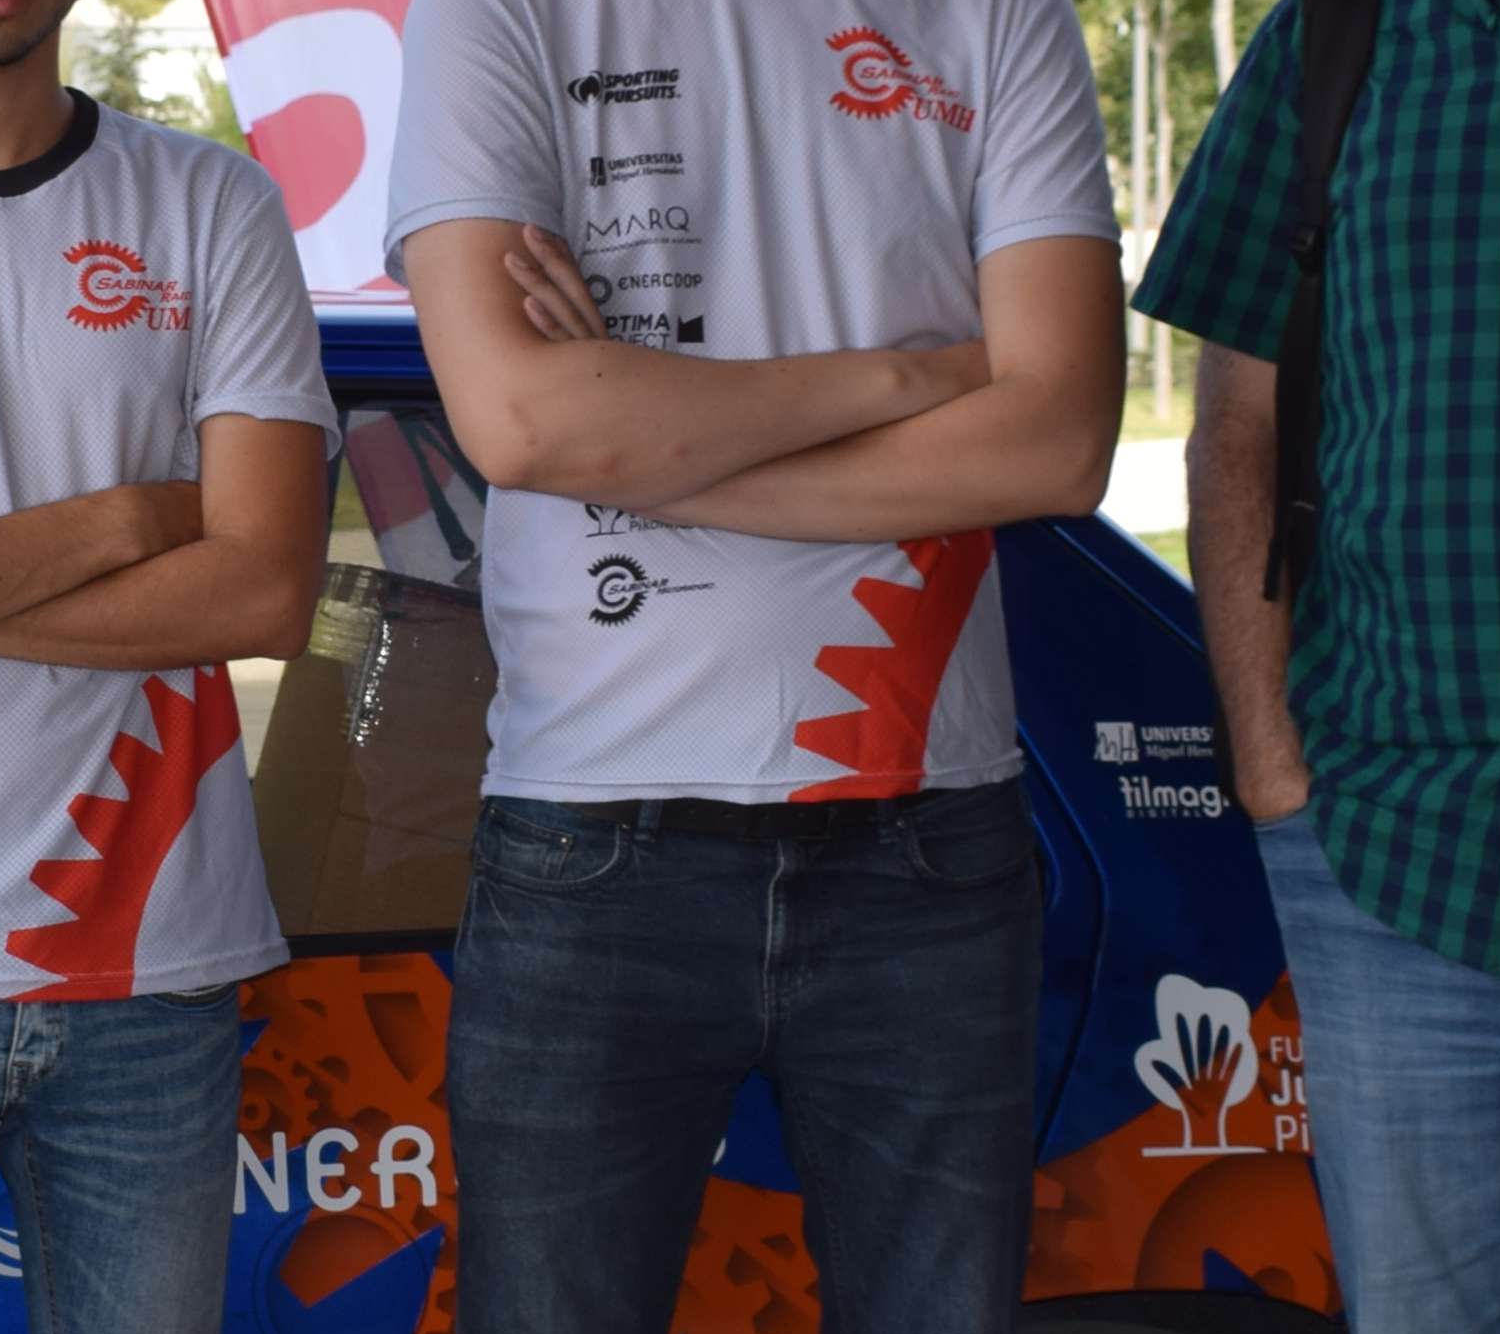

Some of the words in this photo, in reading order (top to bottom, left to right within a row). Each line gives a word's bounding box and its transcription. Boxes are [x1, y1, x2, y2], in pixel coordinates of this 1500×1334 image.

[604, 69, 679, 89] SPORTING
[914, 98, 976, 132] UMH
[607, 153, 683, 172] UNIVERSITAS
[587, 206, 689, 241] MARQ
[96, 278, 178, 291] SABINAR
[606, 313, 670, 331] PTIMA
[1141, 726, 1213, 741] UNIVERS
